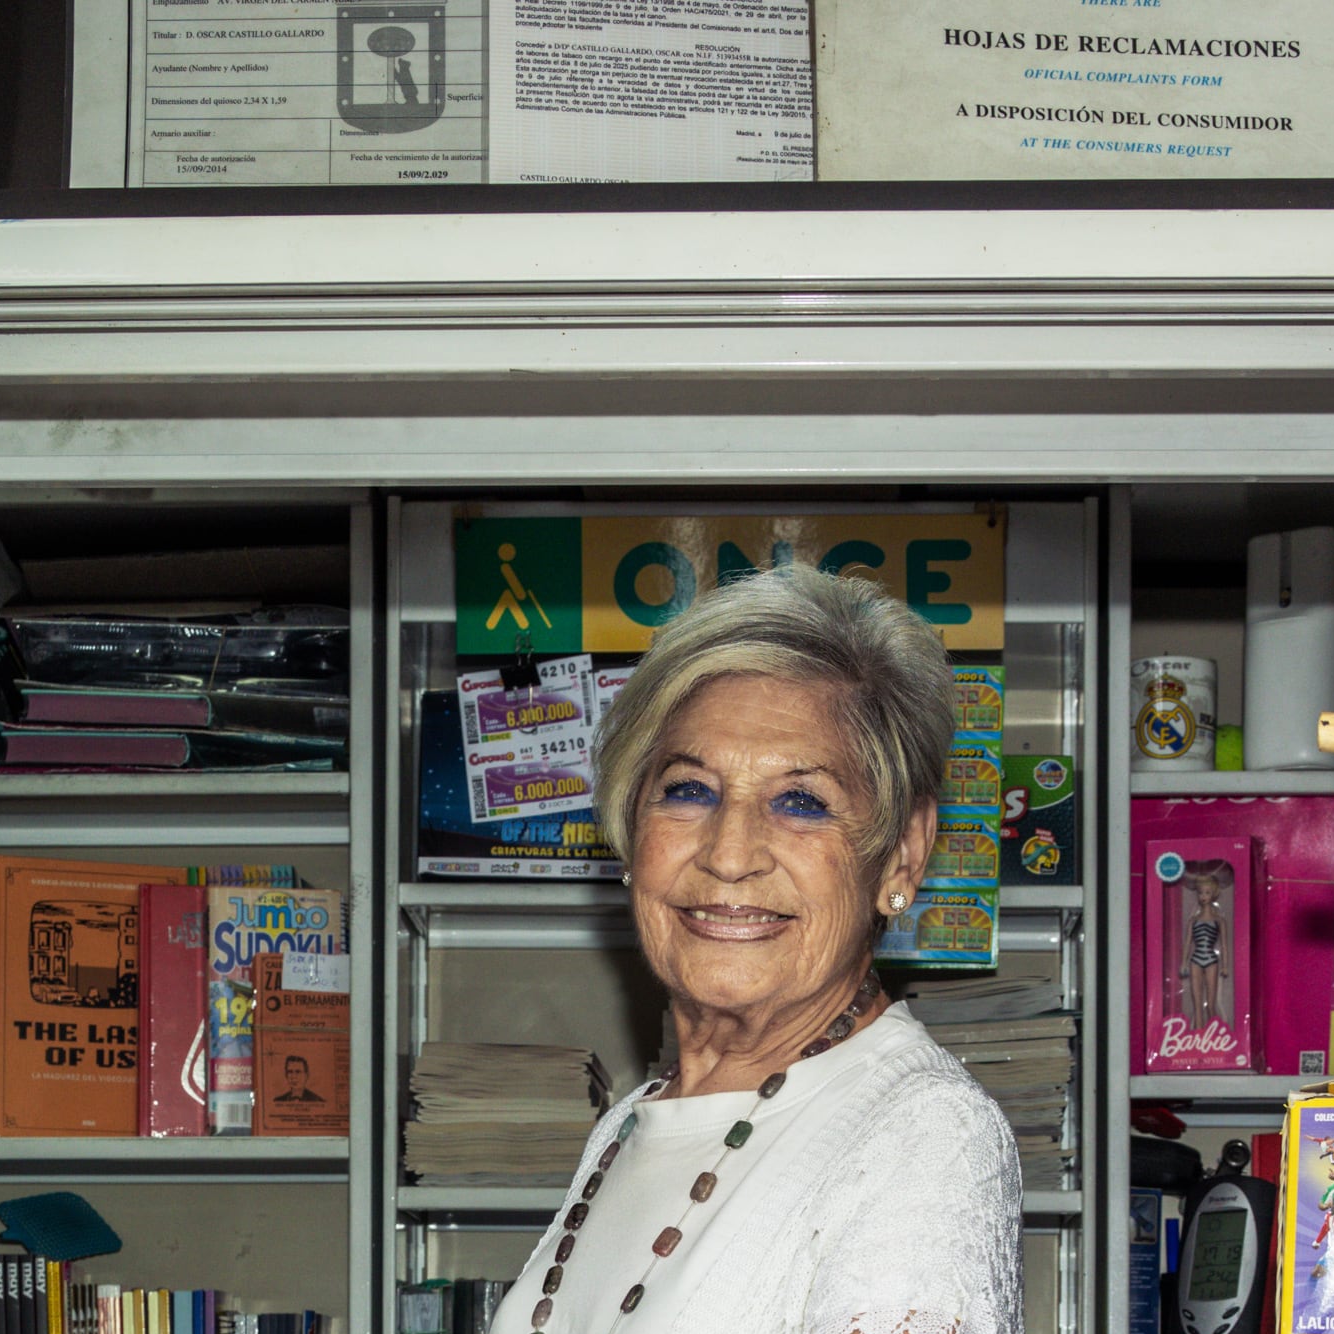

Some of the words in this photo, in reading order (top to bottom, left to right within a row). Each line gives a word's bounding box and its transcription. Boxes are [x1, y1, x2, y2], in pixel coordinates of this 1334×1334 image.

[196, 29, 226, 39] OSCAR
[228, 29, 273, 39] CASTILLO
[276, 29, 325, 39] GALLARDO
[944, 29, 1026, 51] HOJAS
[1034, 33, 1069, 53] DE
[1077, 36, 1301, 59] RECLAMACIONES
[1024, 68, 1083, 81] OFICIAL
[1087, 71, 1177, 85] COMPLAINTS
[1181, 75, 1223, 88] FORM
[956, 104, 970, 118] A
[975, 103, 1106, 125] DISPOSICIÓN
[1112, 111, 1151, 126] DEL
[1157, 114, 1294, 132] CONSUMIDOR
[1020, 137, 1039, 148] AT
[1043, 138, 1072, 150] THE
[1076, 140, 1163, 155] CONSUMERS
[1167, 144, 1233, 158] REQUEST
[1160, 1017, 1237, 1057] Barbie
